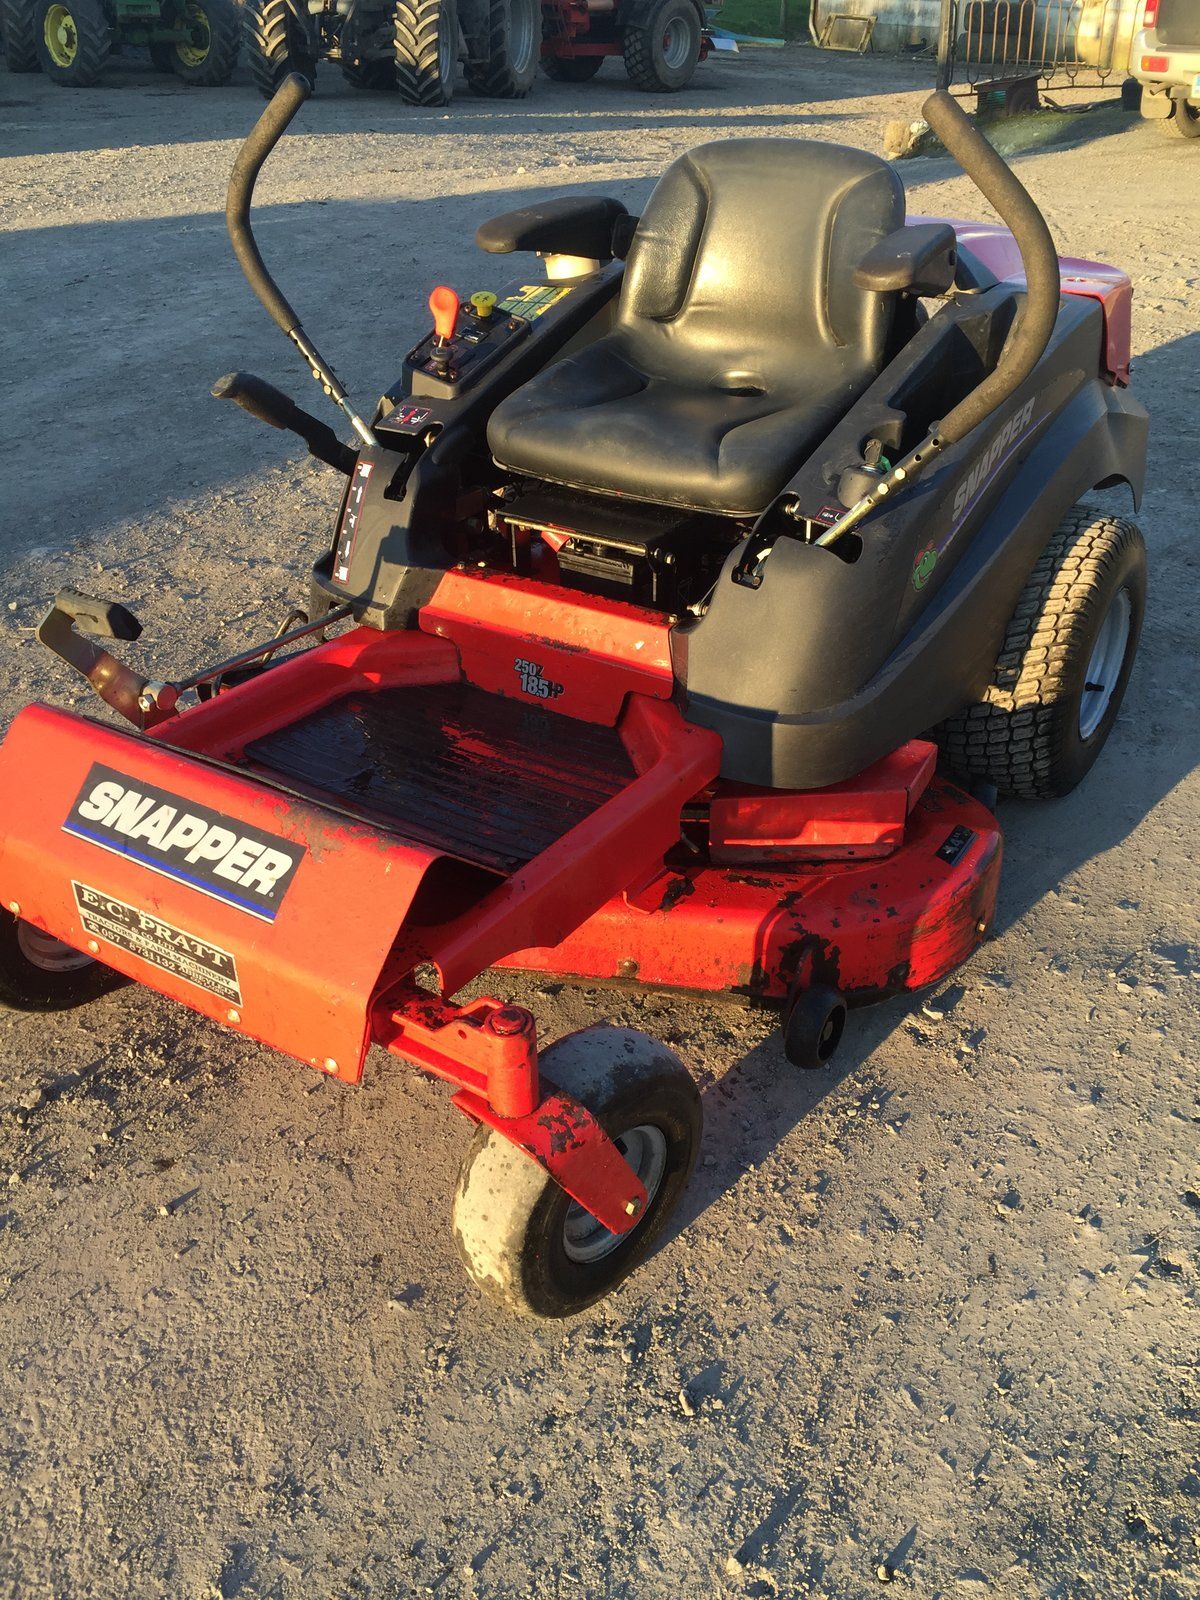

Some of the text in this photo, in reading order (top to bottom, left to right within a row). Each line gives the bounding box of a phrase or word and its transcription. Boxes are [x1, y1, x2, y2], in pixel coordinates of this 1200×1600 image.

[952, 397, 1035, 521] SNAPPER
[78, 781, 293, 895] SNAPPER
[86, 911, 133, 939] TRACTORS
[144, 939, 171, 957] FARM
[173, 953, 231, 987] MACHINERY
[128, 940, 175, 971] 8731132
[138, 915, 228, 967] PRATT
